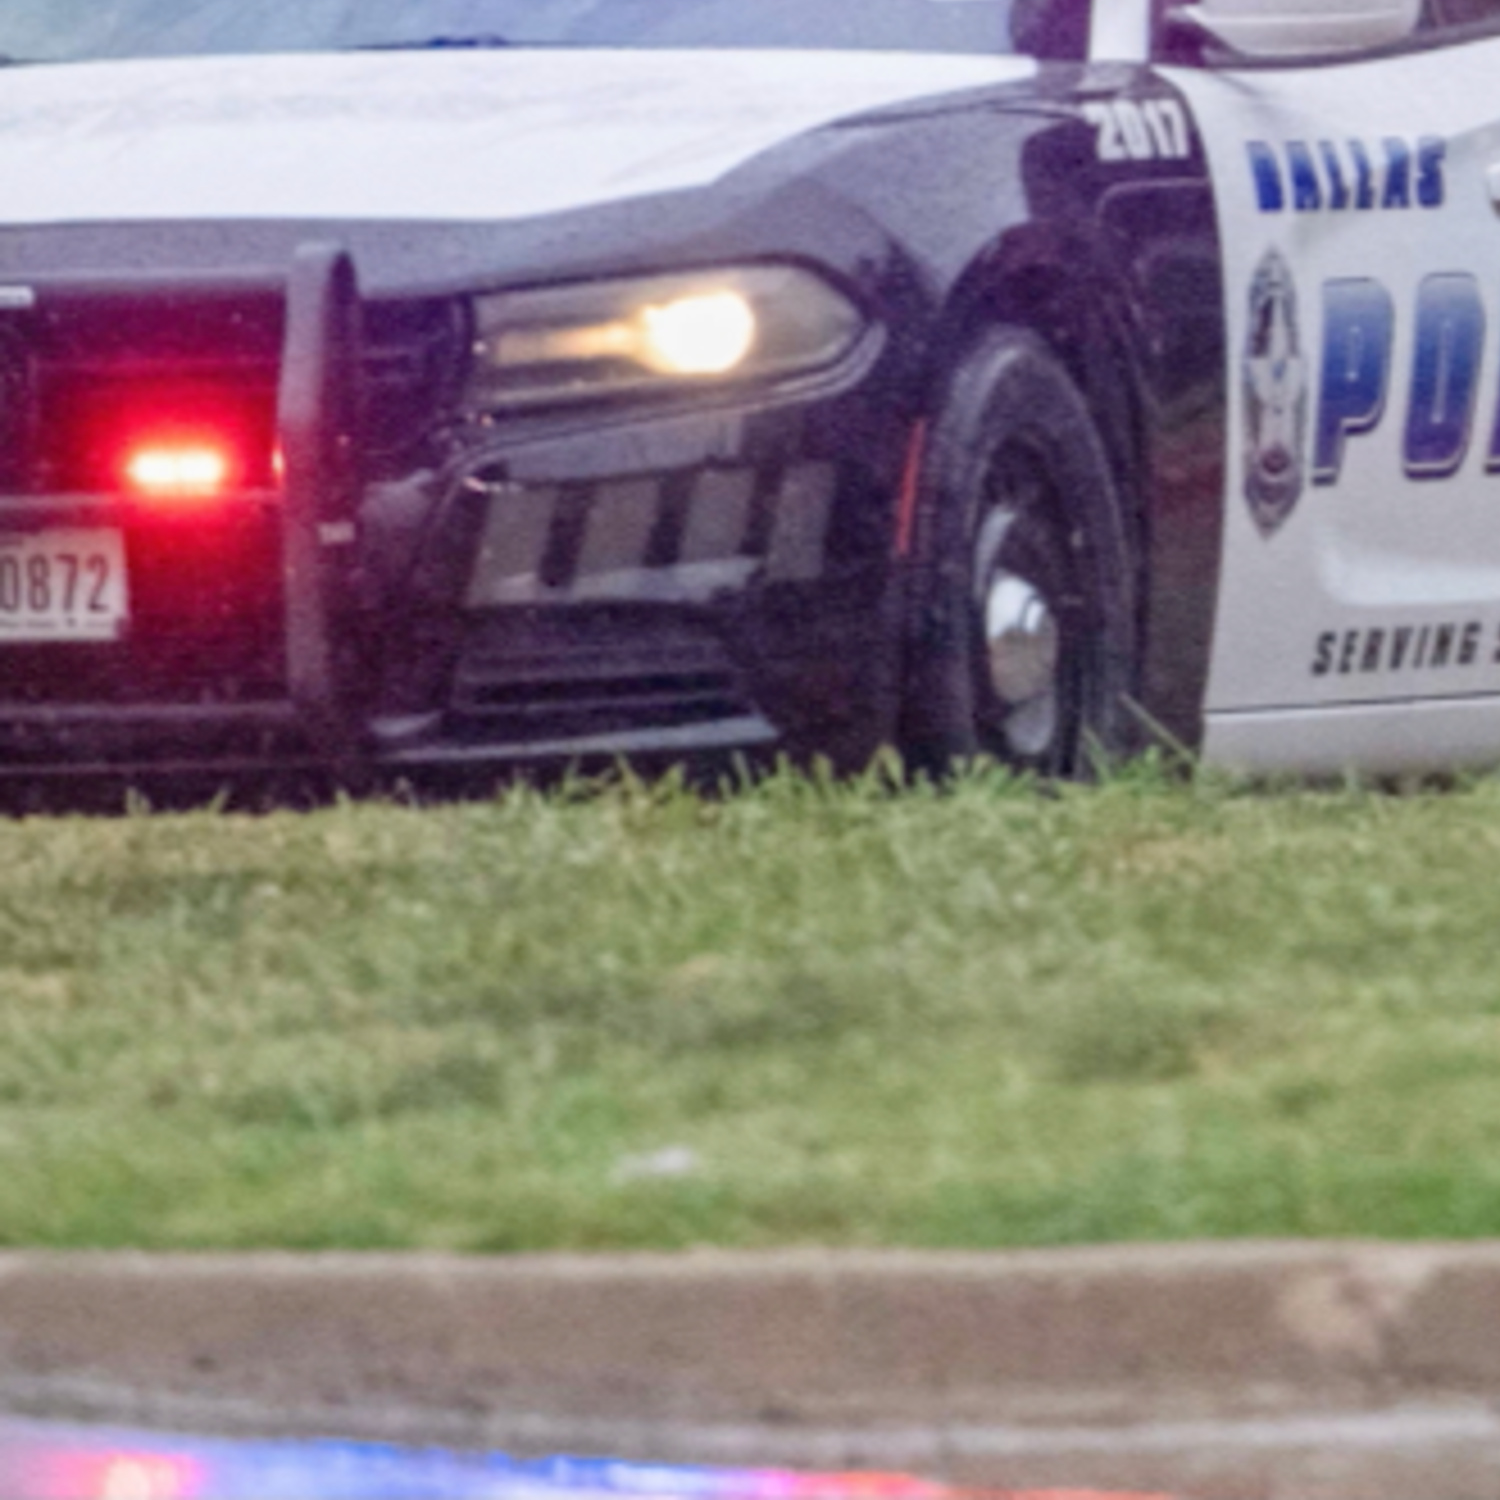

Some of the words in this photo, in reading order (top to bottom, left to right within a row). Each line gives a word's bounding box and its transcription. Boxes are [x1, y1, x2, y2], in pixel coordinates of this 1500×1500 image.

[1085, 99, 1190, 160] 2017
[1245, 135, 1447, 212] DALLAS
[0, 553, 110, 614] 0872
[1311, 620, 1482, 677] SERVING
